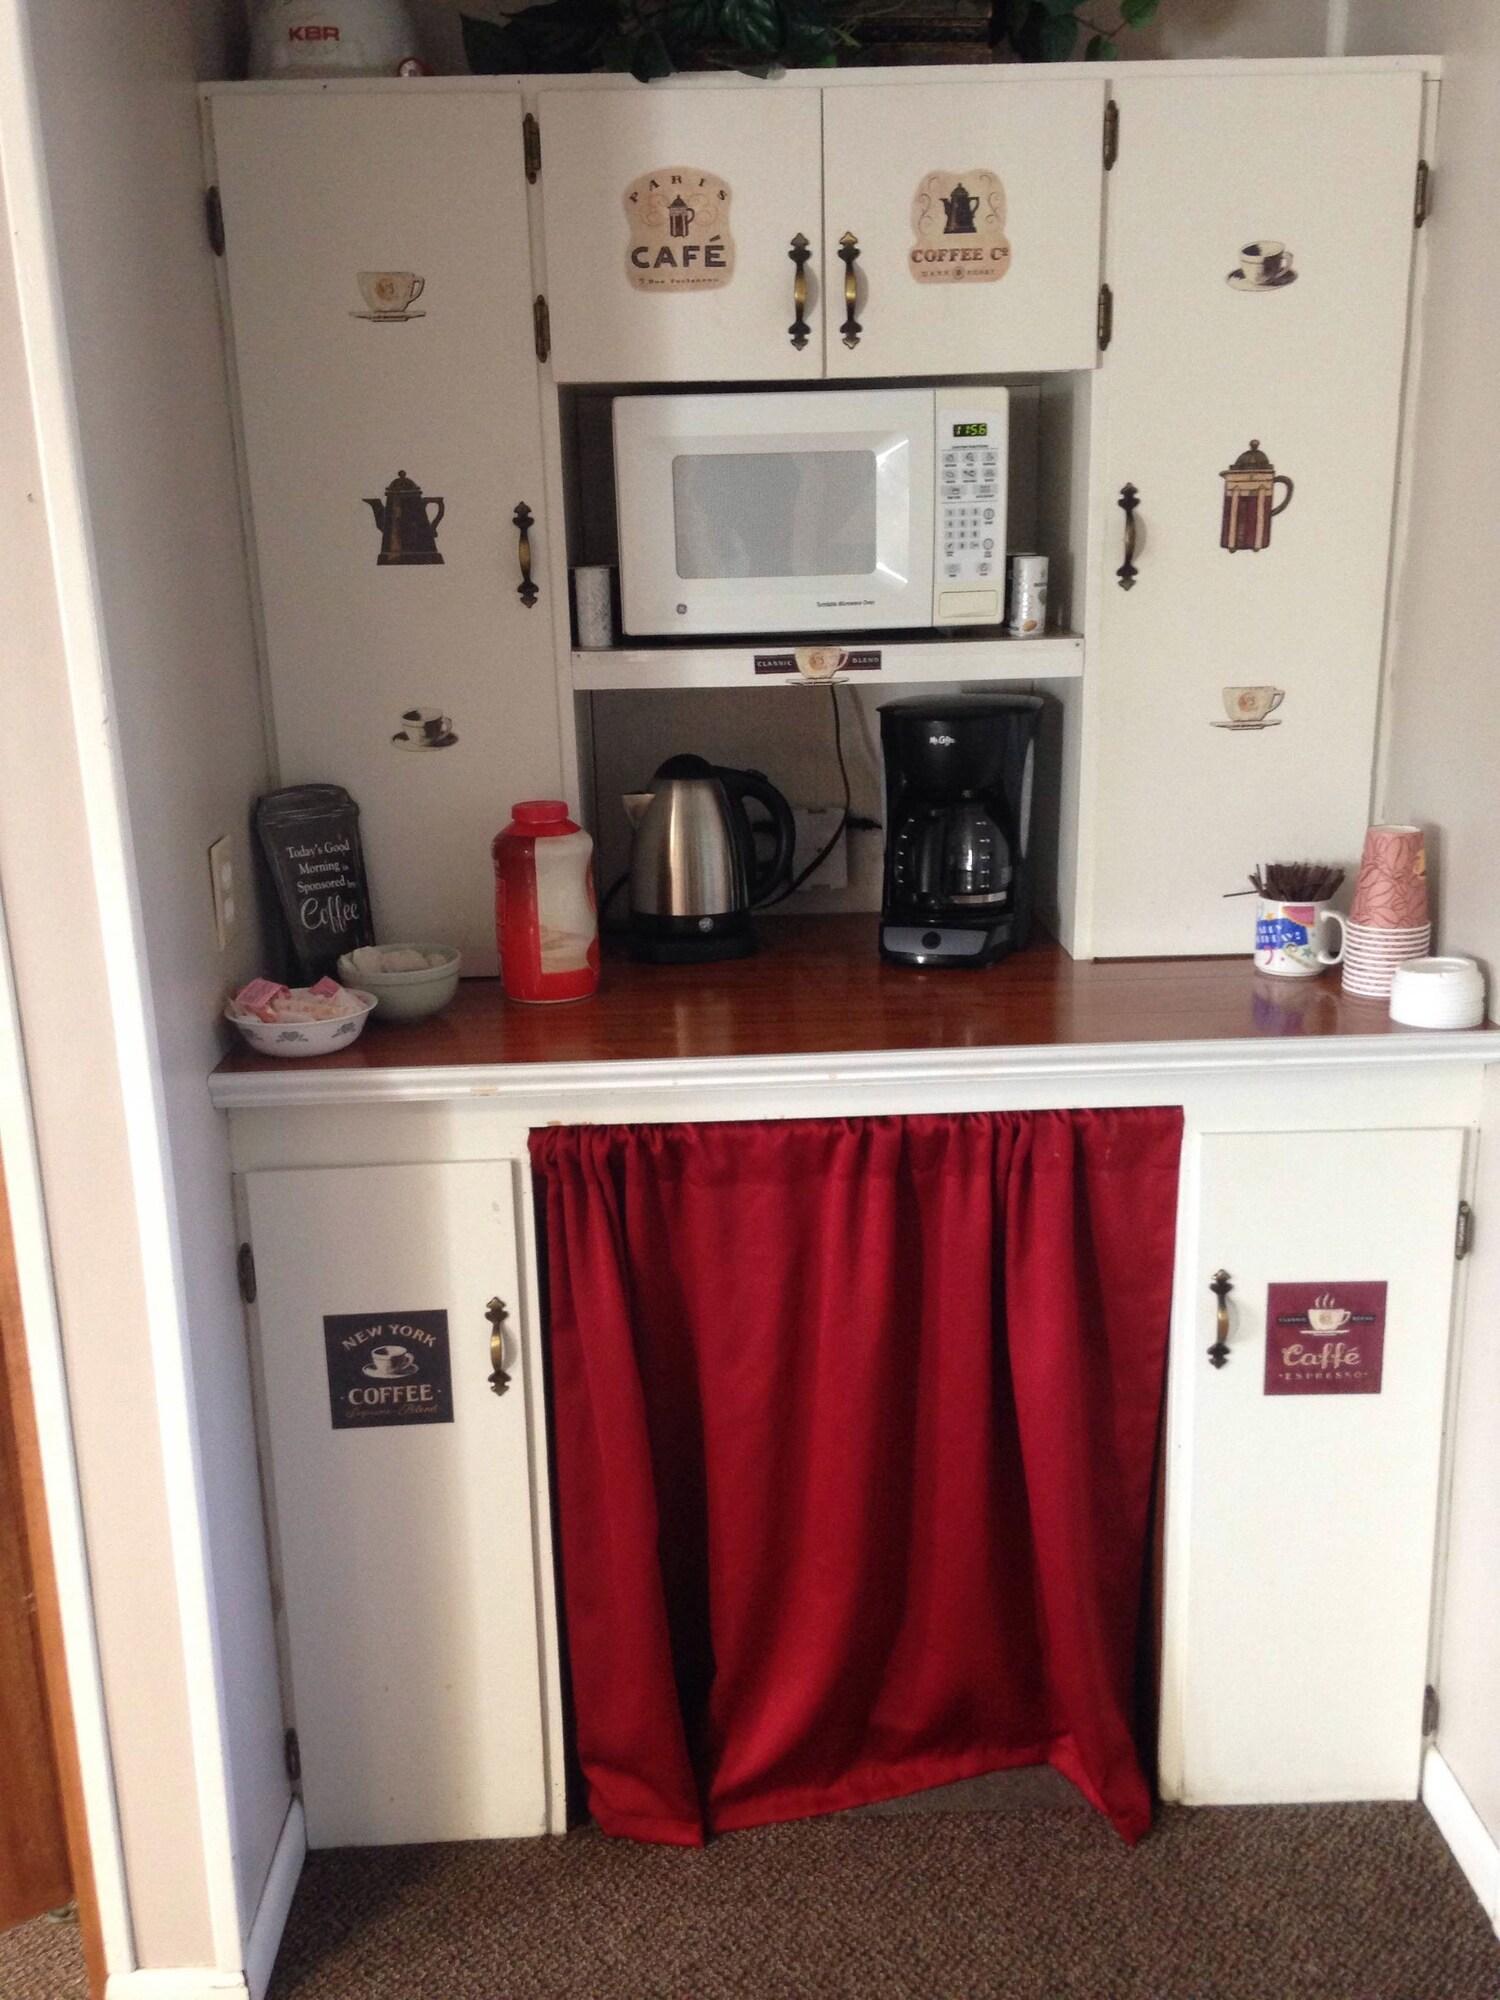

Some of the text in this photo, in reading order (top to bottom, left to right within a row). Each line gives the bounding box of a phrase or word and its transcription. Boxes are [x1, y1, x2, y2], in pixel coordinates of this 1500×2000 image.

[288, 26, 340, 41] KBR
[629, 175, 728, 203] PARIS
[631, 235, 727, 269] CAFÉ
[911, 247, 984, 264] COFFEE
[286, 840, 350, 859] Today's Good
[299, 862, 341, 875] Morning
[297, 874, 346, 895] Sponsored
[301, 894, 360, 934] Coffee
[341, 1323, 437, 1351] NEW YORK
[1281, 1342, 1361, 1370] Caffé
[348, 1384, 433, 1406] COFFEE
